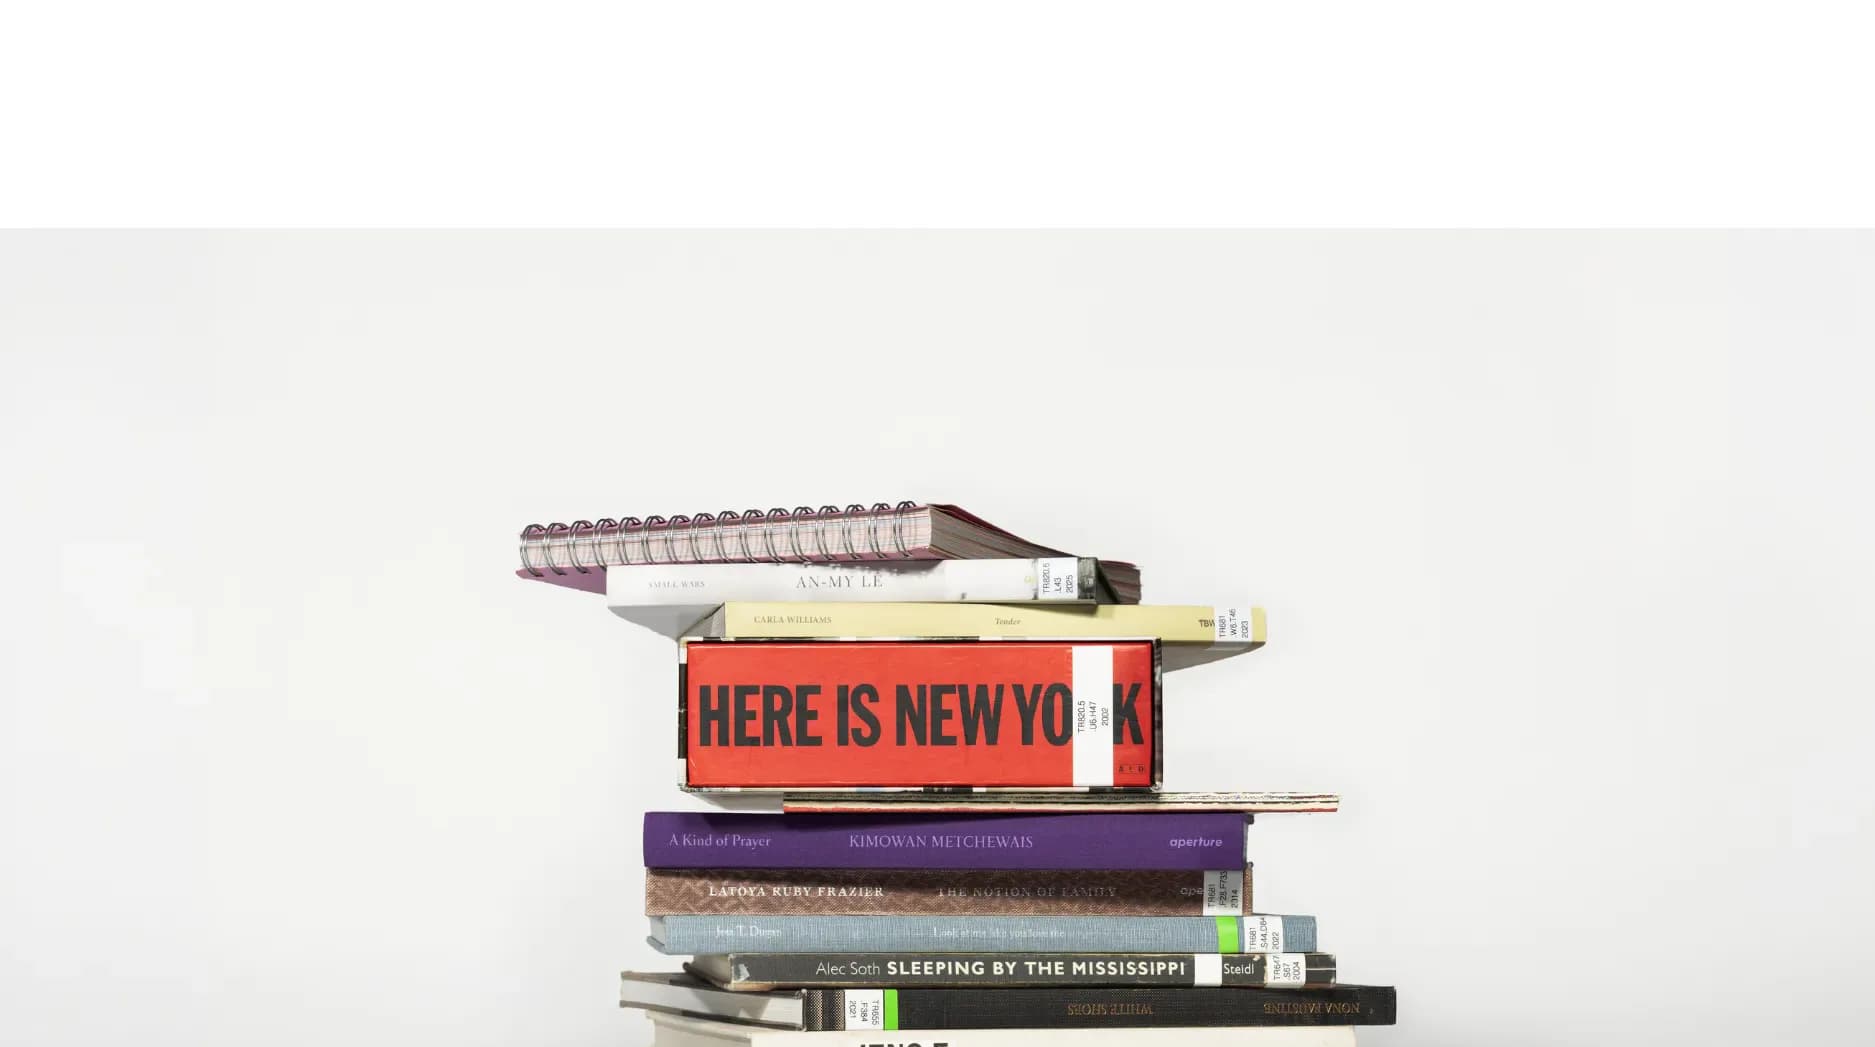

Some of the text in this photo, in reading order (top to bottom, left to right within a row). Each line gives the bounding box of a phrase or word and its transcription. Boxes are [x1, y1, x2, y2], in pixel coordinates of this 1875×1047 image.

[681, 580, 705, 589] WARS
[796, 575, 853, 588] AN-MY
[754, 616, 832, 625] CARLA WILLIAMS
[995, 617, 1021, 626] Tender
[700, 683, 1145, 747] HERE IS NEW YOK
[1089, 701, 1097, 732] .U6.H47
[669, 833, 772, 850] A Kind of Prayer
[850, 835, 1034, 848] KIMOWAN METCHEWAIS
[1169, 836, 1223, 848] aperture
[708, 886, 884, 897] LATOYA RUBY FRAZIER
[938, 887, 1118, 897] THE NOTION OF FAMILY
[815, 961, 1185, 976] Alec Soth SLEEPING BY THE MISSISSIPPI
[1223, 963, 1255, 975] Steidl
[1067, 1003, 1153, 1016] WHITE SHOES
[1263, 1002, 1360, 1014] NONA FAUSTINE
